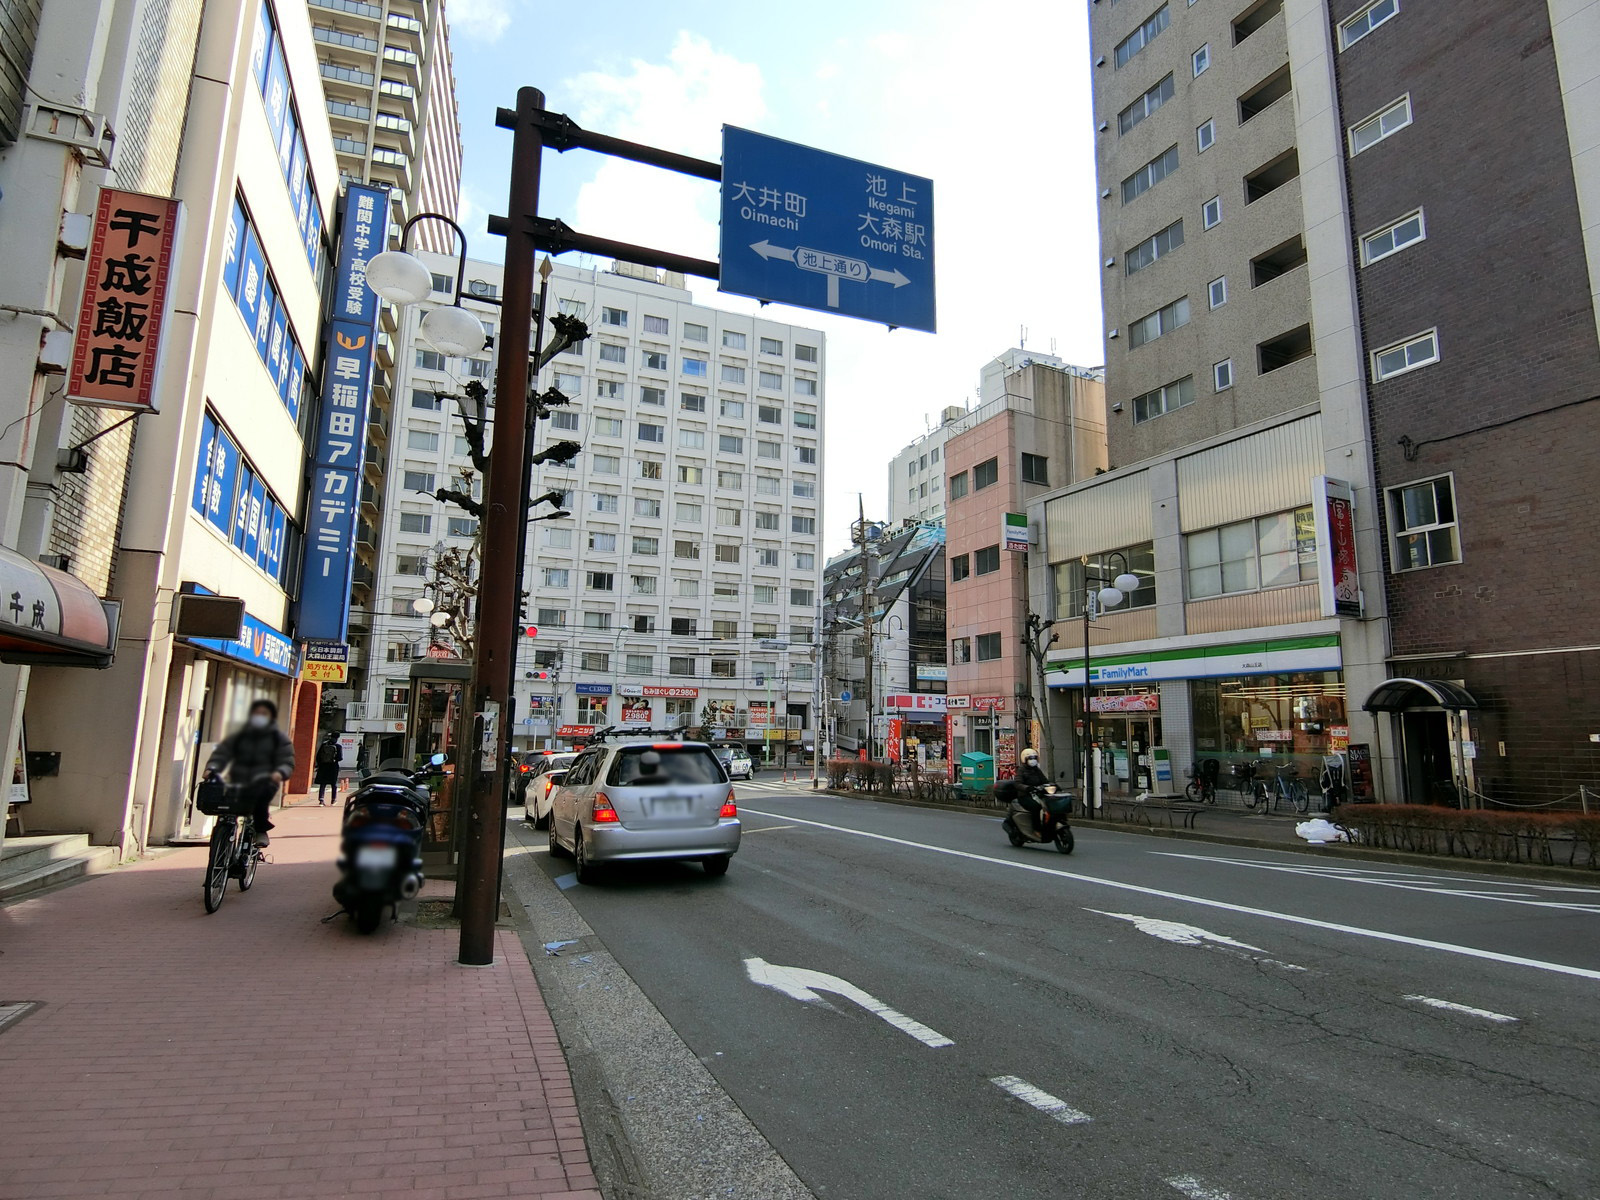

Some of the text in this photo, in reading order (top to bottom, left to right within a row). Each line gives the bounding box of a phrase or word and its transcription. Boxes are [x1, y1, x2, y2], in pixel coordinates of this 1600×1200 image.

[732, 181, 807, 217] 大井町
[865, 173, 917, 205] 池上
[740, 206, 799, 231] Oimachi
[868, 197, 915, 218] Ikegami
[858, 212, 926, 247] 大森駅
[345, 195, 374, 315] 難関中学・高校受験
[860, 235, 925, 260] Omori Sta.
[803, 252, 862, 276] 池上通り
[317, 356, 361, 577] 早稲田アカデミー
[307, 663, 335, 671] 処方せん
[1101, 666, 1148, 679] FamilyMart
